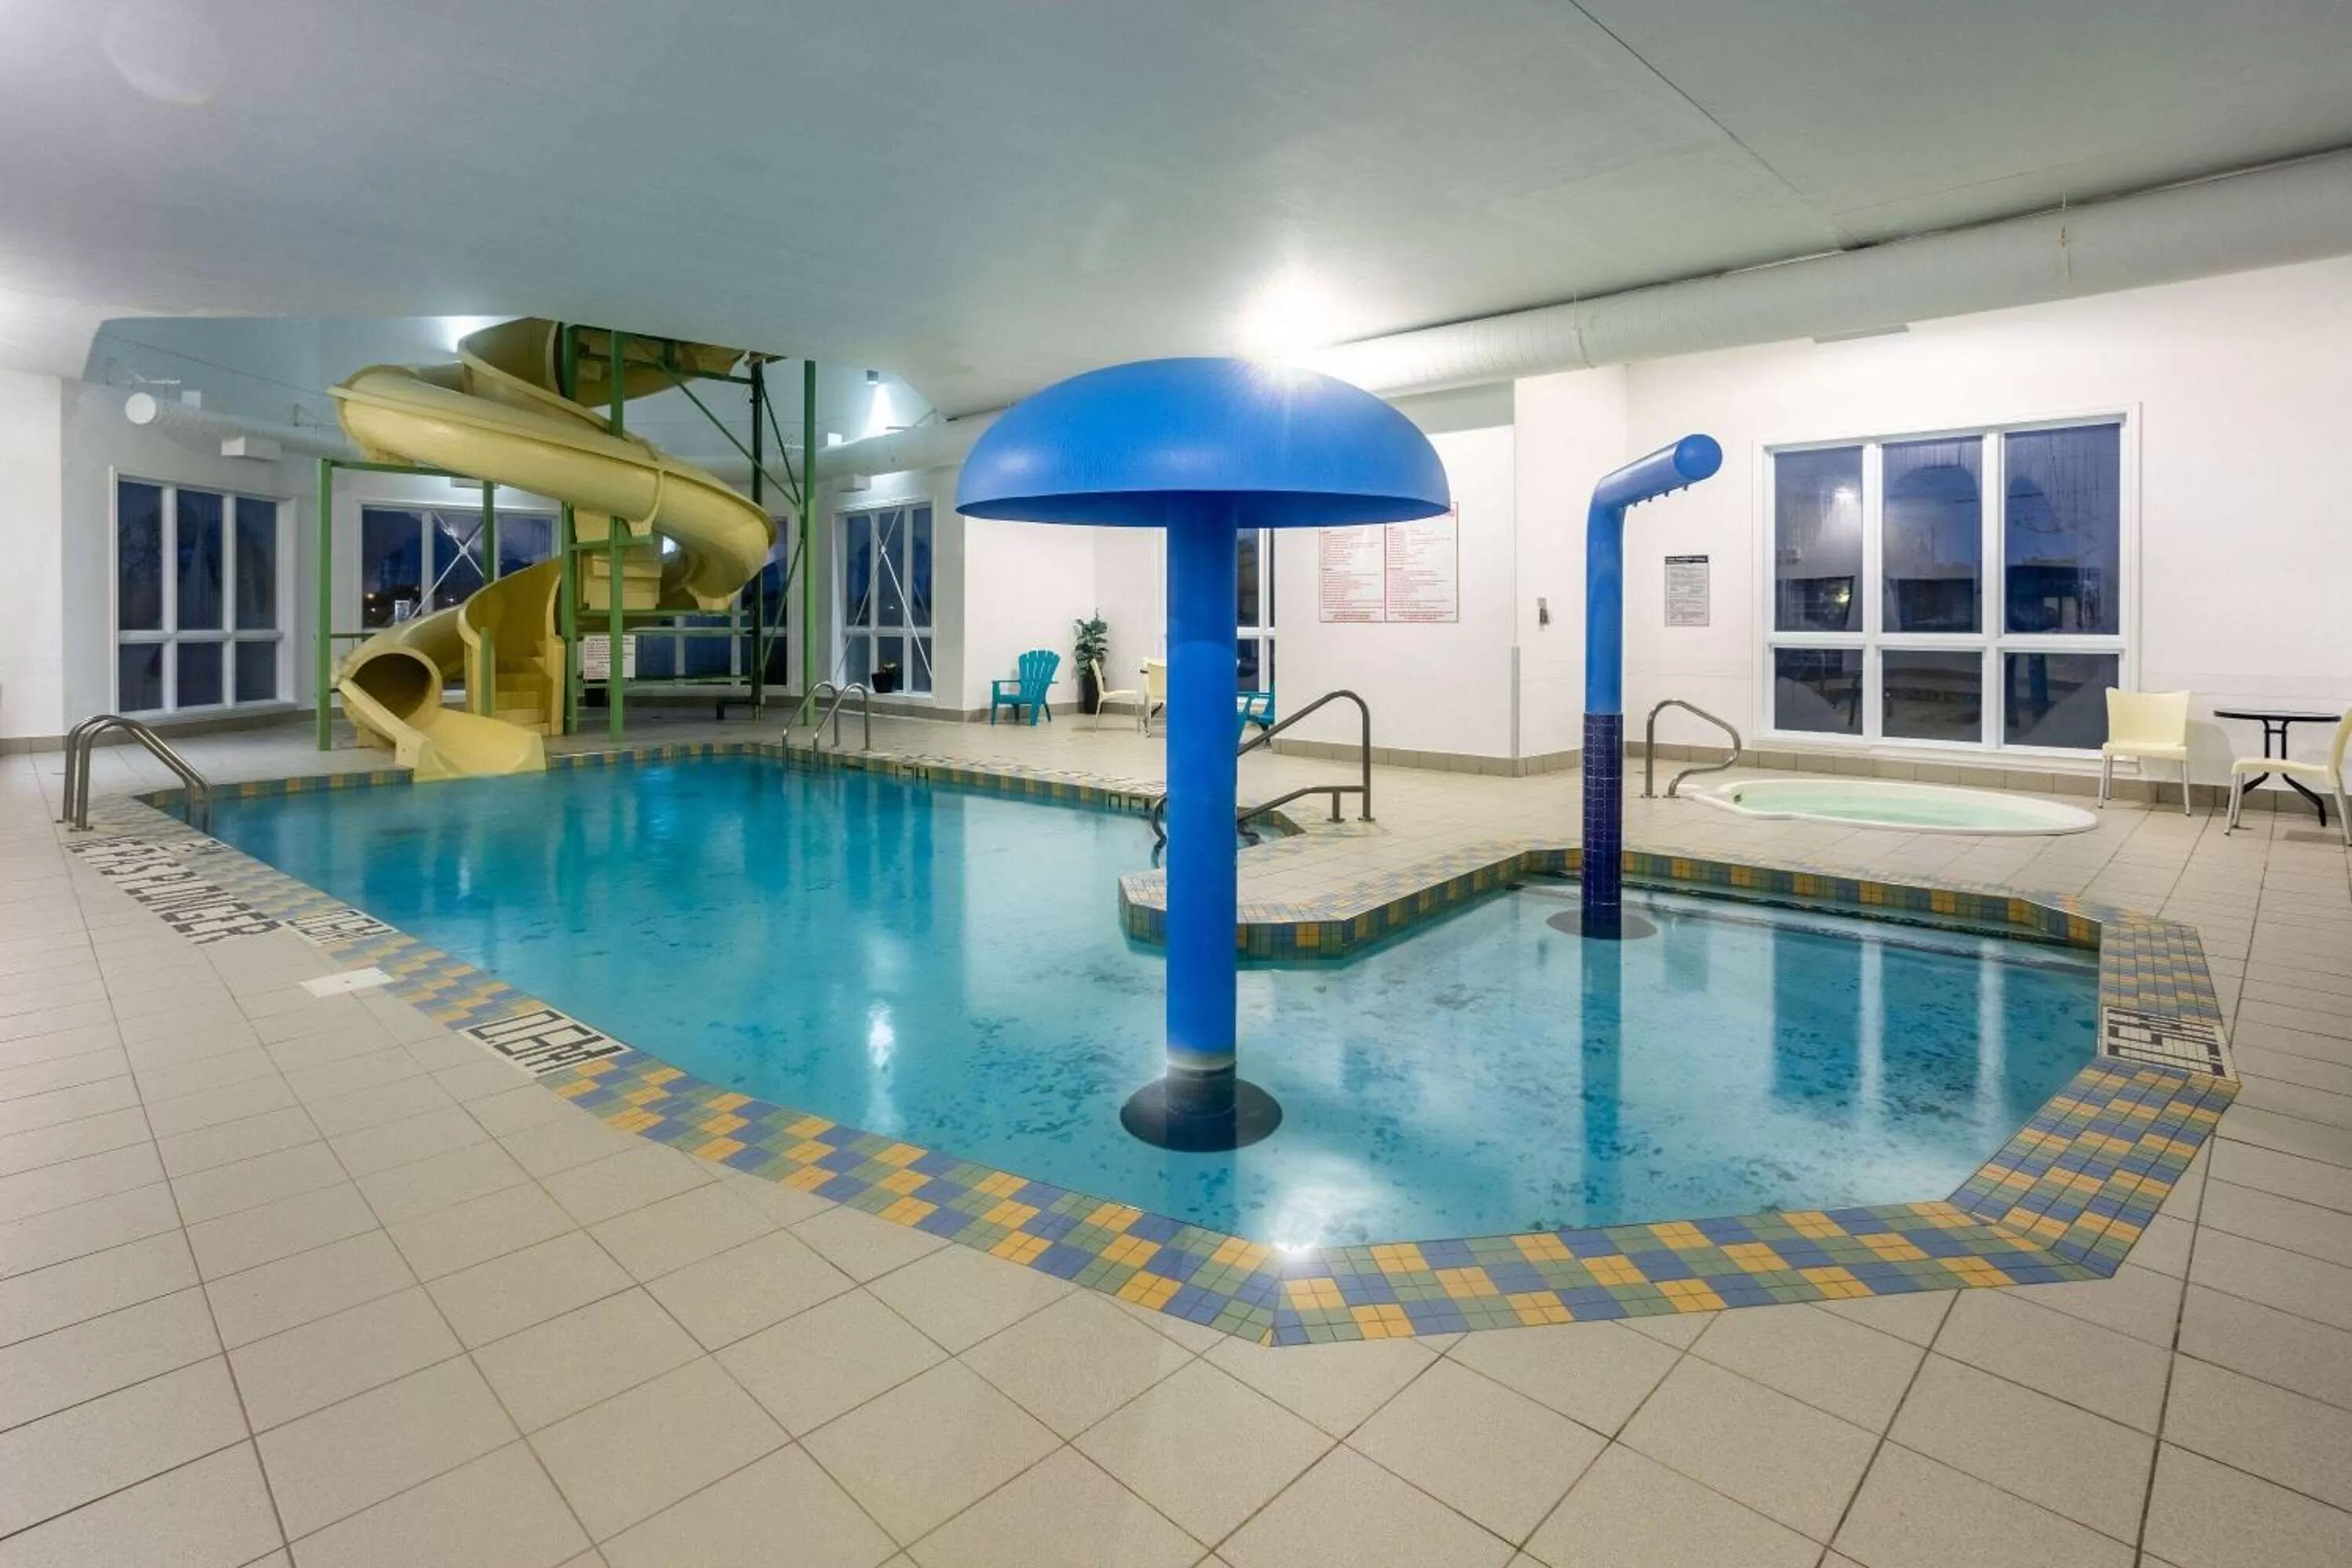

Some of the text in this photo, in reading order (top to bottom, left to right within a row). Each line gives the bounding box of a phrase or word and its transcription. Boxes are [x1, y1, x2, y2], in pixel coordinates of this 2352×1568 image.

[82, 848, 181, 877] PAS
[114, 871, 282, 945] PLONGER
[467, 1009, 623, 1073] 0.6M
[2107, 1007, 2227, 1078] 0.5M
